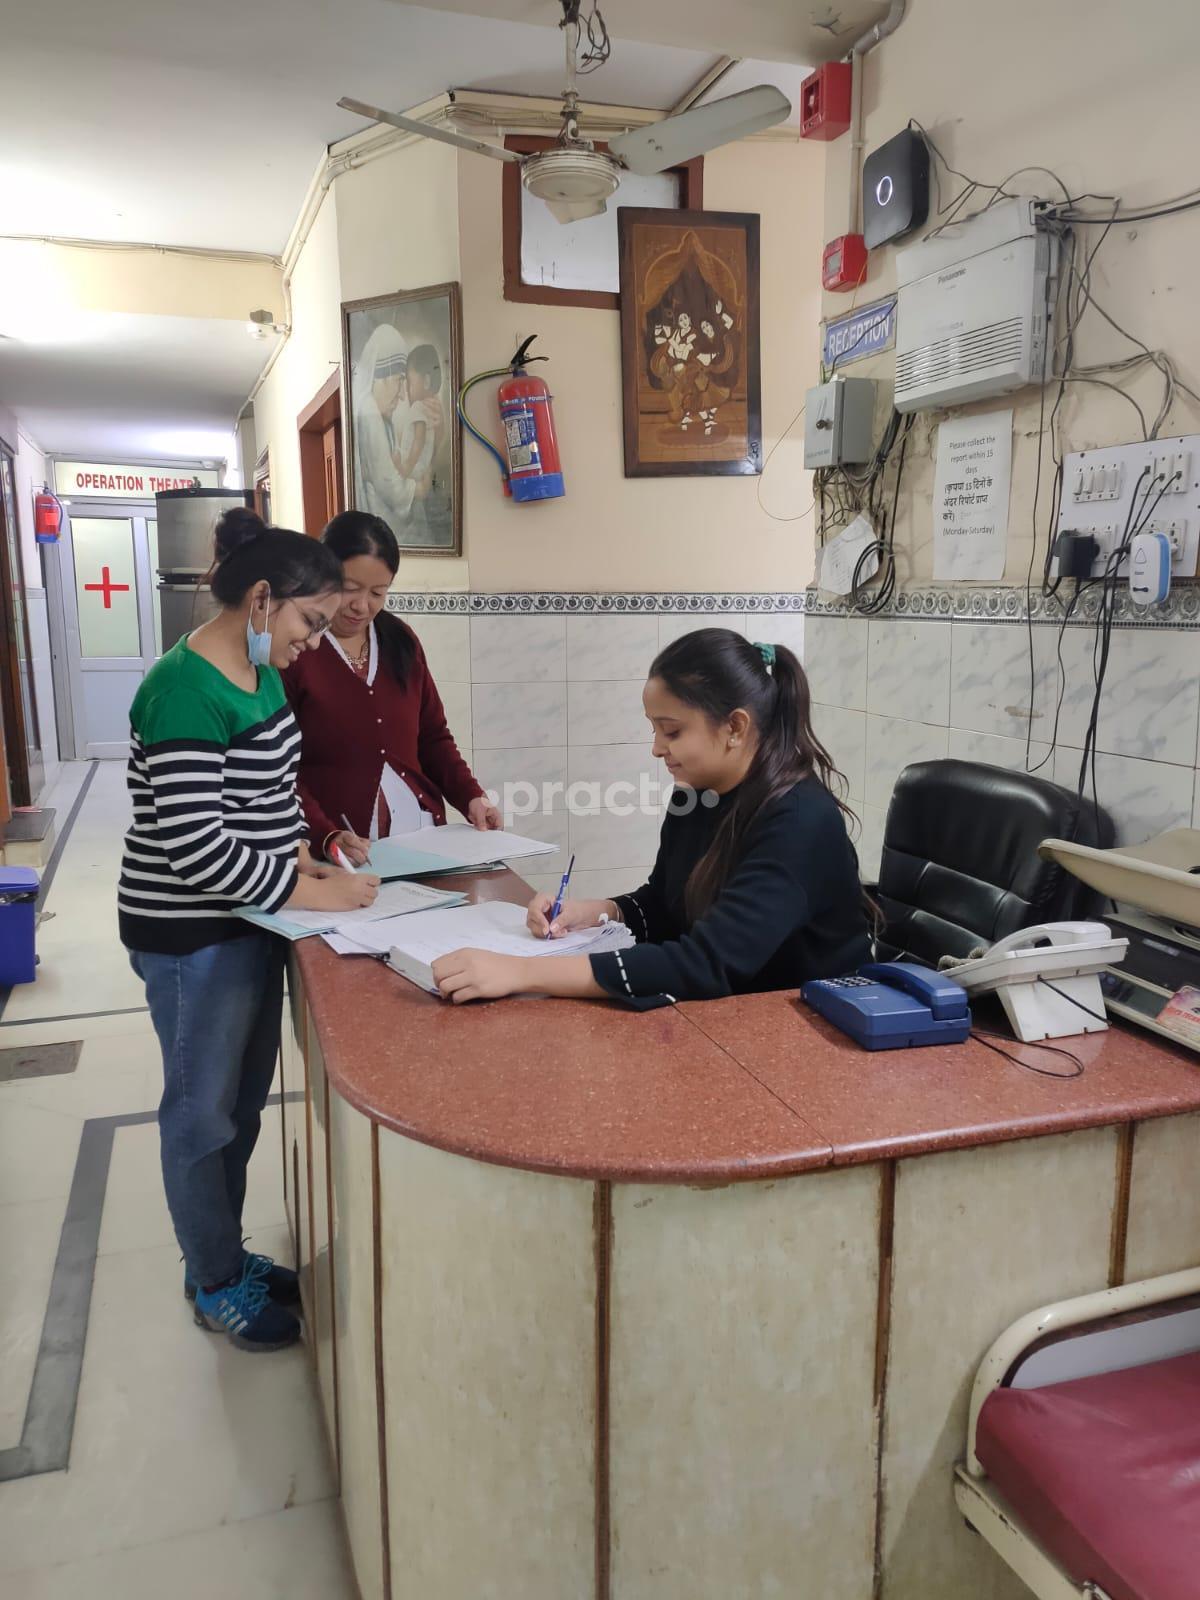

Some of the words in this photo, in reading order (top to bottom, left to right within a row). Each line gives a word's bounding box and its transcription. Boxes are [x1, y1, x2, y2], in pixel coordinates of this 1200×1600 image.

[828, 313, 890, 358] RECEPTION
[949, 441, 966, 449] Please
[967, 438, 985, 447] collect
[950, 453, 968, 463] report
[969, 450, 986, 460] within
[986, 449, 994, 458] 15
[965, 465, 977, 474] days
[76, 472, 144, 491] OPERATION
[965, 481, 972, 491] 15
